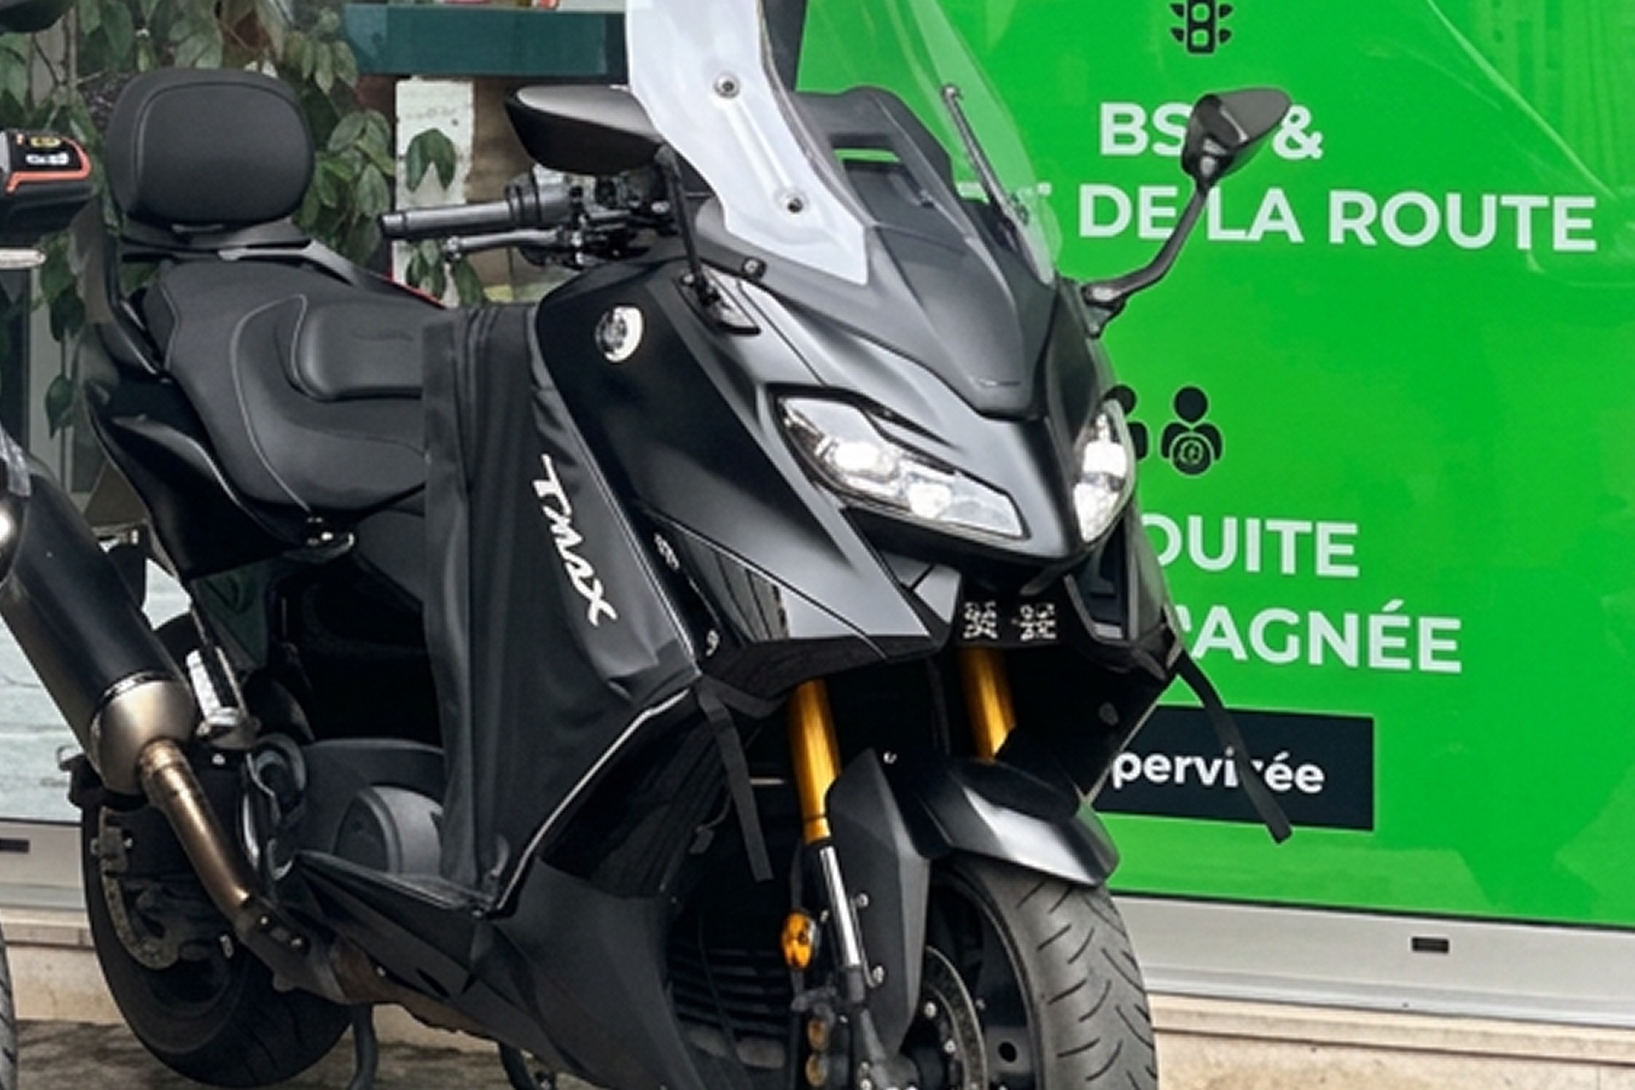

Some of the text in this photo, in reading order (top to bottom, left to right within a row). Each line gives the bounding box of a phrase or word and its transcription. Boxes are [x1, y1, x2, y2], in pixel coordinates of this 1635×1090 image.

[1100, 102, 1323, 160] BS &
[1079, 183, 1178, 239] DE
[1206, 185, 1305, 243] LA
[1329, 190, 1597, 252] ROUTE
[1175, 599, 1463, 673] AGNÉE
[1112, 746, 1325, 794] perviée
